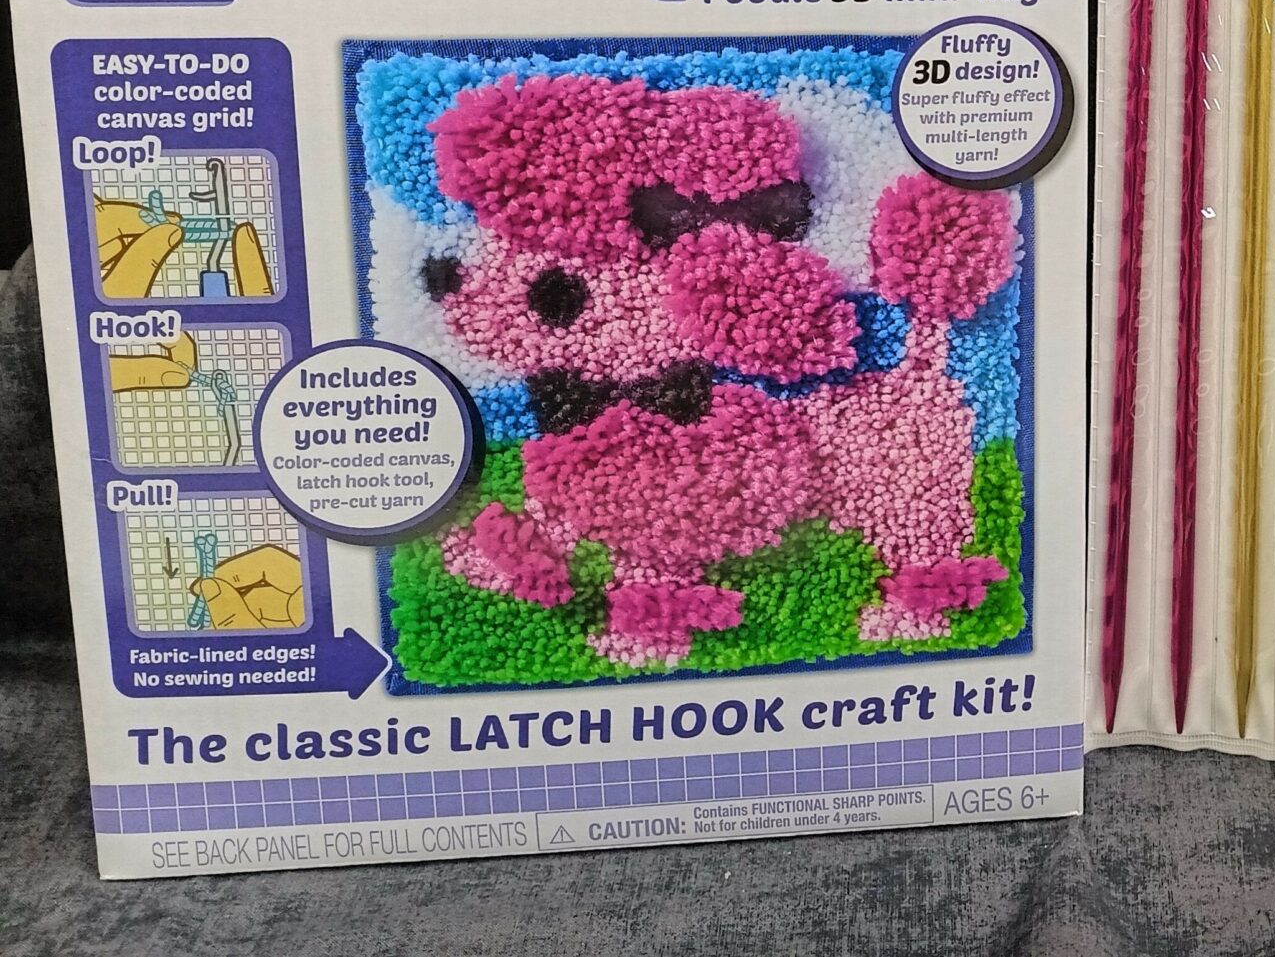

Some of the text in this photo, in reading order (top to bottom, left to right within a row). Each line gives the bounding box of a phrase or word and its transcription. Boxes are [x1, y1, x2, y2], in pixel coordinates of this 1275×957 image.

[941, 32, 1012, 58] Fluffy
[92, 53, 250, 75] EASY-TO-DO
[912, 59, 1040, 85] 3D design!
[93, 80, 253, 102] color-coded
[901, 88, 1051, 108] Super fluffy effect
[96, 108, 254, 132] canvas grid!
[919, 109, 1033, 128] with premium
[924, 127, 1028, 145] multi-length
[79, 141, 156, 168] Loop!
[955, 148, 1000, 166] yarn!
[95, 315, 175, 338] Hook!
[300, 367, 418, 390] Includes
[281, 394, 437, 420] everything
[294, 421, 431, 450] you need!
[272, 452, 455, 471] Color-coded canvas,
[297, 471, 435, 491] latch hook tool,
[112, 483, 172, 507] Pull!
[309, 494, 424, 513] pre-cut yarn
[129, 643, 317, 665] Fabric-lined edges!
[133, 666, 317, 690] No sewing needed!
[127, 673, 1037, 766] The classic LATCH HOOK craft kit!
[694, 791, 926, 820] Contains FUNCTIONAL SHARP POINTS.
[944, 785, 1050, 816] AGES 6+
[588, 817, 687, 842] CAUTION:
[694, 811, 881, 834] Not for children under 4 years.
[151, 820, 528, 869] SEE BACK PANEL FOR FULL CONTENTS
